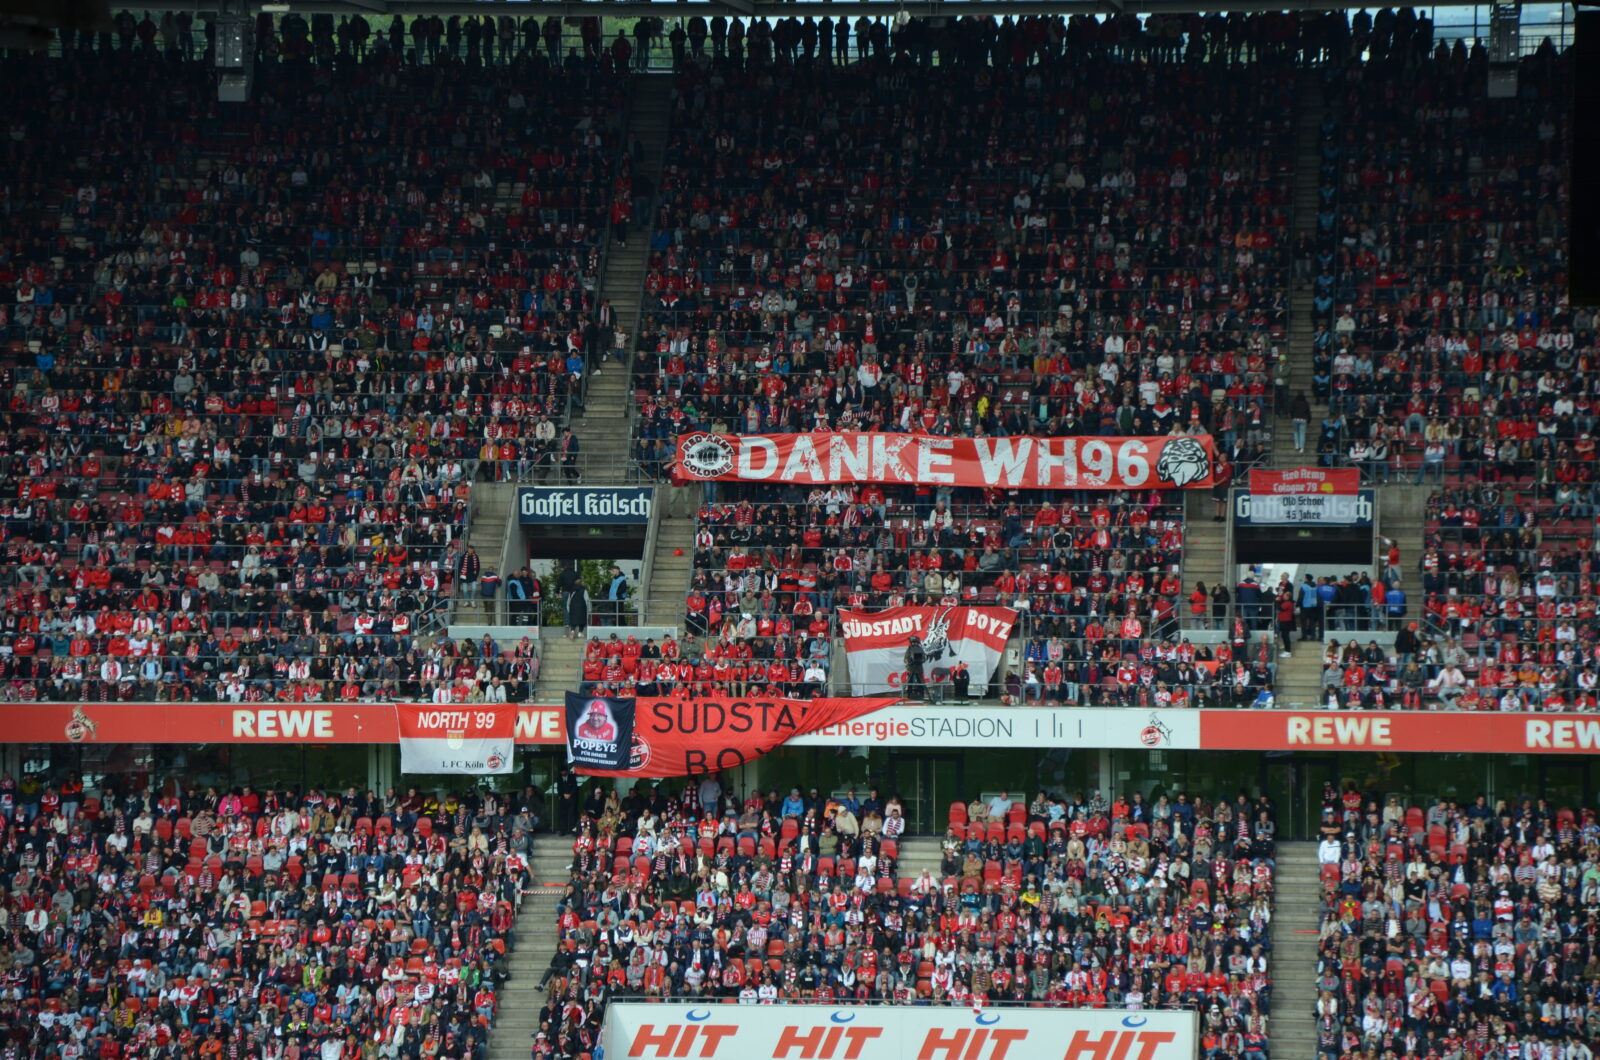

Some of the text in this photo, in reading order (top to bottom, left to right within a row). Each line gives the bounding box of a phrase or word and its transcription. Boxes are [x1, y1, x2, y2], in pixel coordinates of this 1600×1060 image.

[682, 434, 736, 456] RED ARMY
[683, 461, 733, 477] COLOGNE
[737, 435, 1150, 487] DANKE WH96
[1300, 468, 1326, 482] Army
[1272, 482, 1318, 494] Cologne 79
[1282, 496, 1325, 507] Old School
[521, 492, 651, 519] Gaffel Kölsch
[1285, 509, 1321, 521] 45 Jahre
[842, 608, 1013, 641] SÜDSTADT BOYZ
[232, 709, 335, 738] REWE
[417, 711, 470, 729] NORTH
[514, 710, 562, 739] WE
[651, 697, 809, 735] SÜDSTA
[807, 717, 1013, 742] EnergieSTADION
[1286, 716, 1393, 746] REWE
[1526, 719, 1600, 749] REW
[573, 738, 618, 754] POPEYE
[450, 760, 463, 768] FC
[465, 760, 484, 769] Köln
[627, 1024, 740, 1058] HIT
[772, 1025, 884, 1060] HIT
[917, 1027, 1030, 1060] HIT
[1063, 1030, 1177, 1060] HIT
